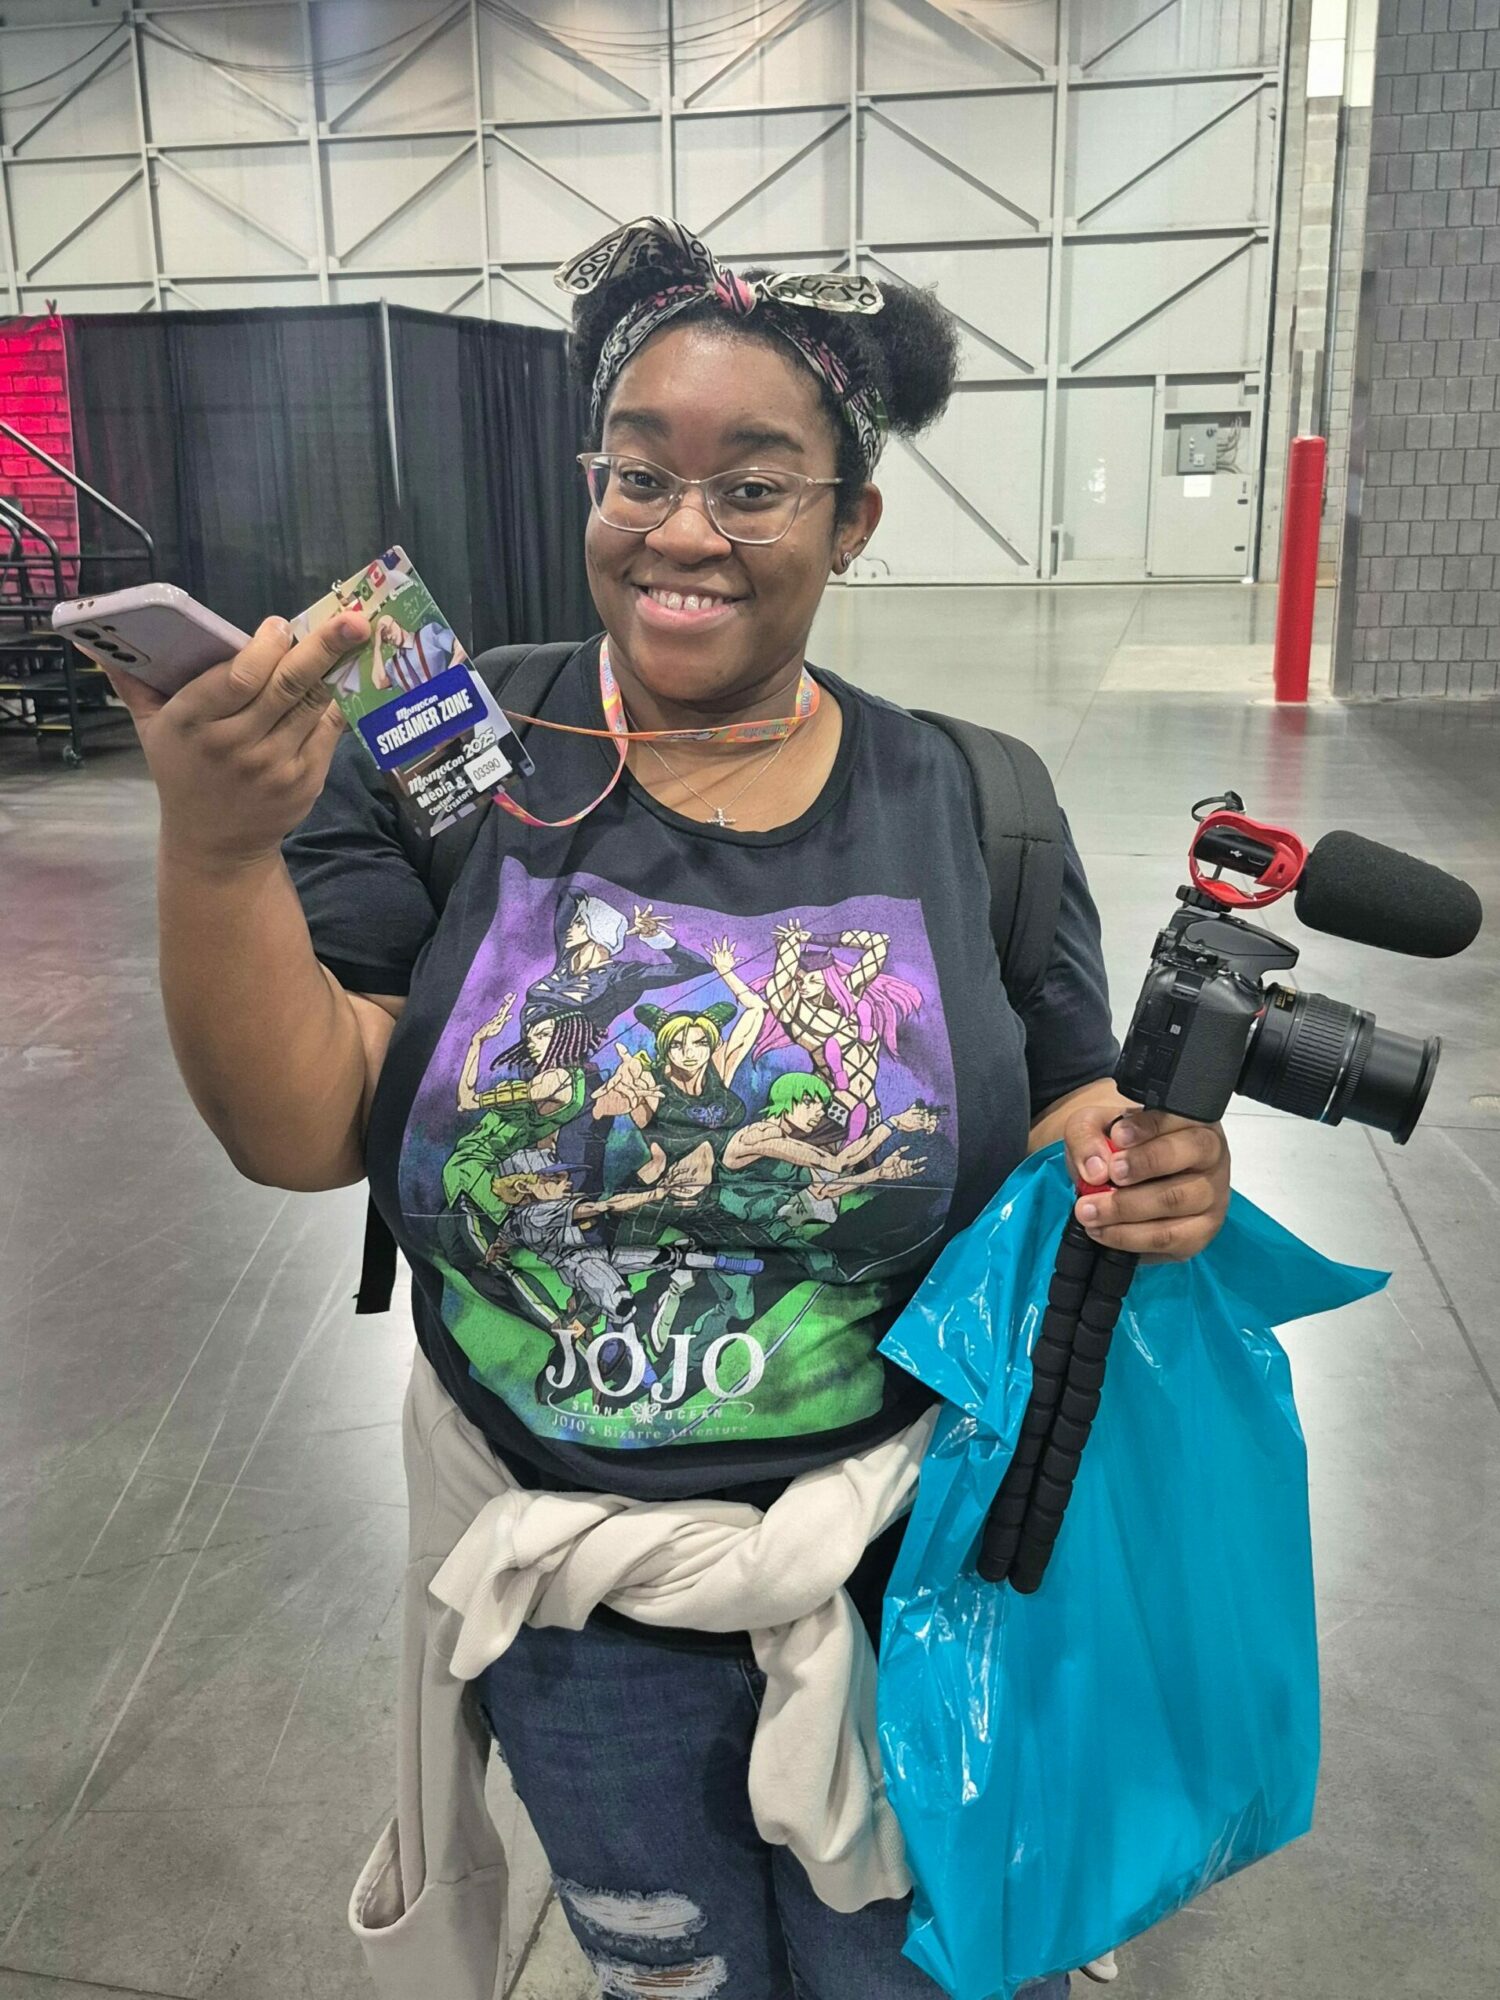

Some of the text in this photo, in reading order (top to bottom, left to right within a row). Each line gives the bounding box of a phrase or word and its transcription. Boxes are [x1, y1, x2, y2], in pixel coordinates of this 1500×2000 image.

[377, 688, 473, 755] STREAMER ZONE
[408, 727, 496, 795] MomoCon 2025
[473, 758, 501, 781] 03390
[455, 776, 467, 789] &
[429, 794, 455, 815] Content
[445, 788, 474, 813] Creators
[546, 1329, 765, 1403] JOJO
[572, 1400, 624, 1417] STONE
[551, 1414, 596, 1436] JOJO's
[604, 1425, 662, 1440] Bizarre
